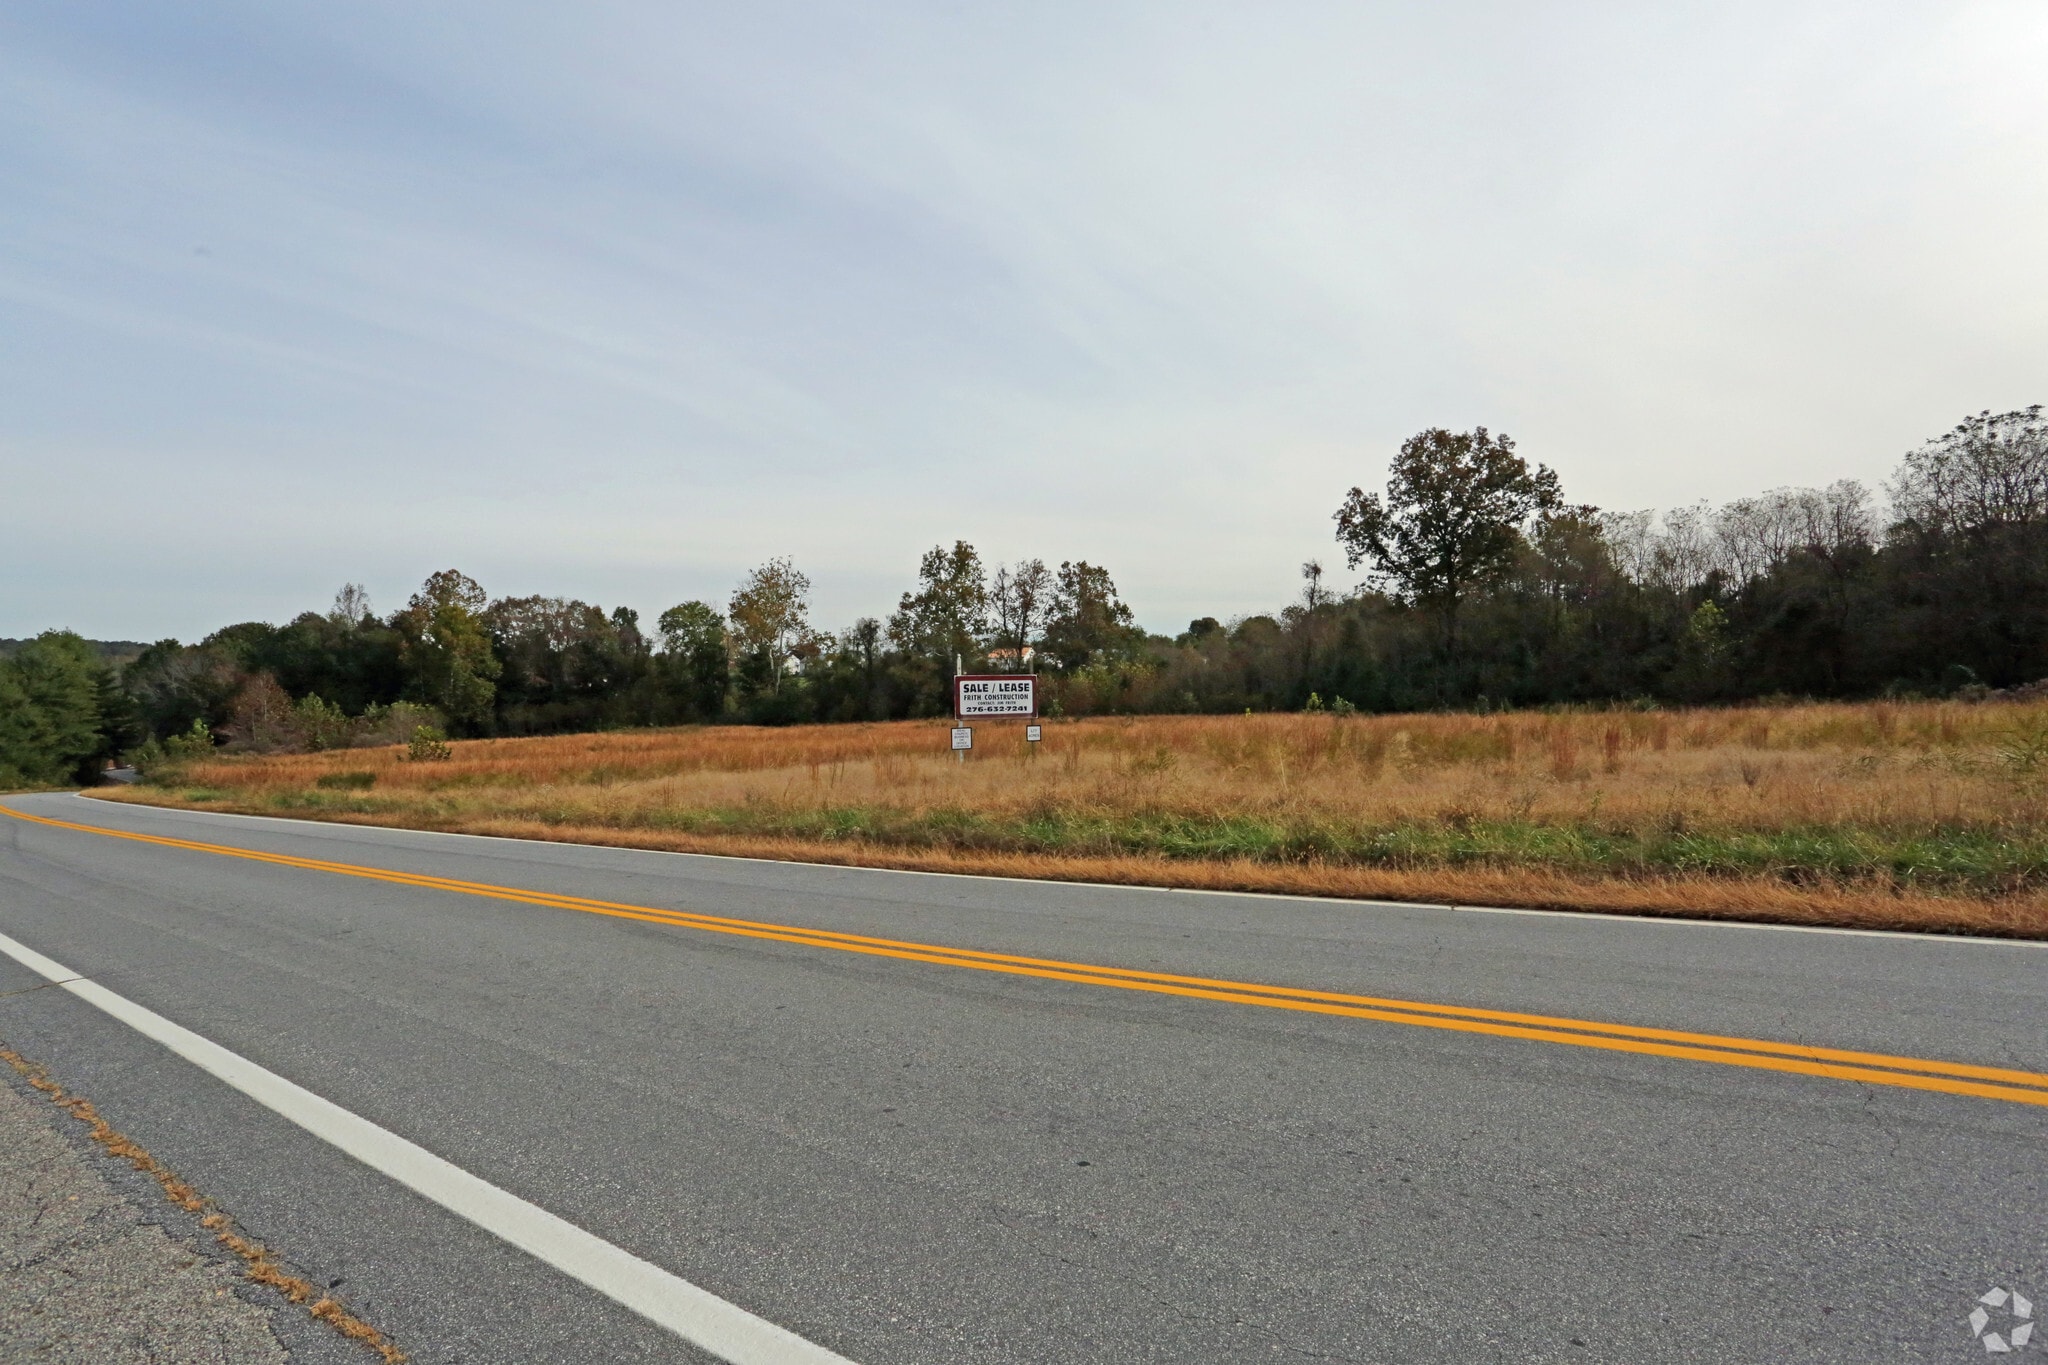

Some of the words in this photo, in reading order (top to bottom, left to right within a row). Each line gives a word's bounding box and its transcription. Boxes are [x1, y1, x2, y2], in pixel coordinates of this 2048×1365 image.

[963, 684, 988, 692] SALE
[992, 684, 996, 693] /
[999, 683, 1030, 692] LEASE
